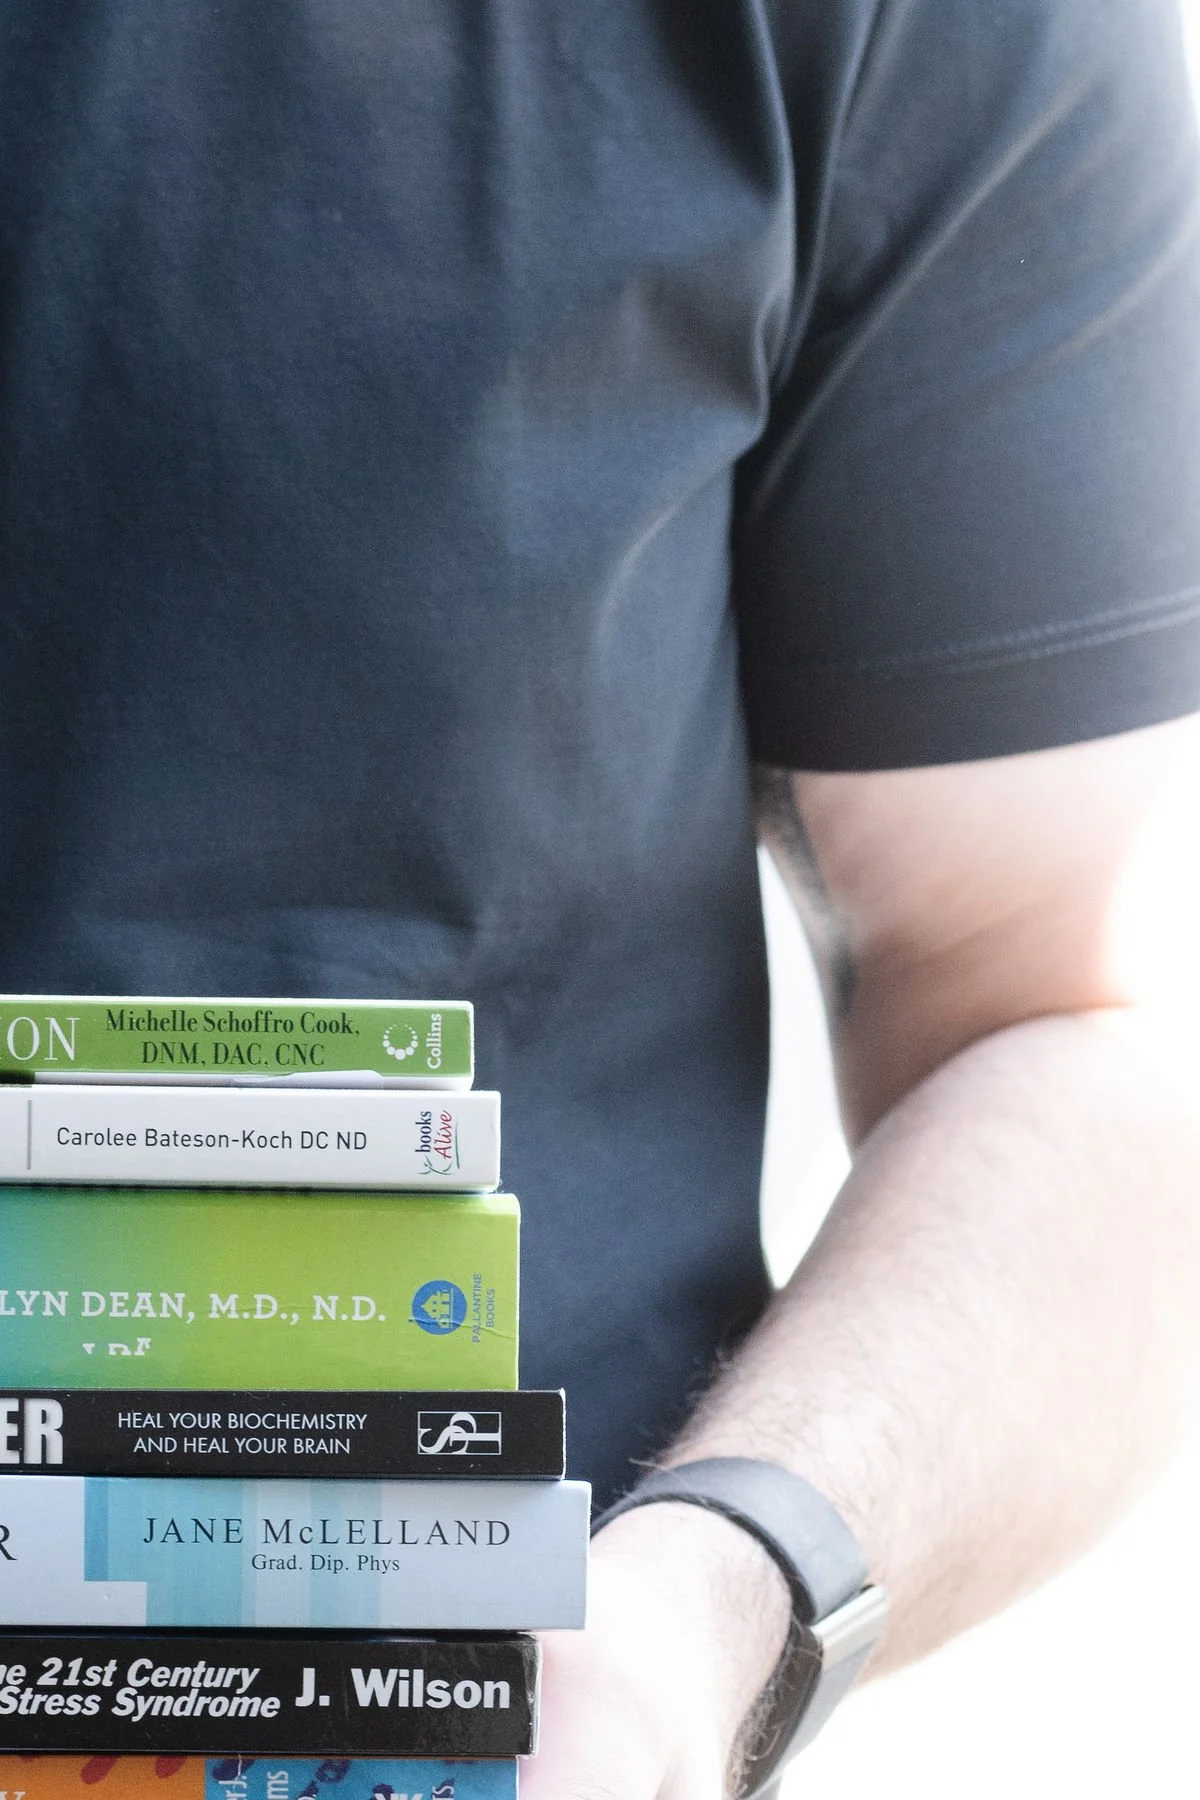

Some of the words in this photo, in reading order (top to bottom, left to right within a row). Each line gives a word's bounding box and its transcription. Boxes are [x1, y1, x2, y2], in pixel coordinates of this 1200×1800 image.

[106, 1008, 197, 1032] Michelle
[203, 1011, 294, 1034] Schoffro
[300, 1012, 360, 1036] Cook,
[276, 1044, 325, 1067] CNC
[426, 1013, 442, 1069] Collins
[56, 1127, 137, 1148] Carolee
[144, 1128, 293, 1151] Bateson-Koch
[299, 1129, 329, 1151] DC
[336, 1129, 368, 1151] ND
[415, 1111, 431, 1152] books
[434, 1110, 452, 1159] Alive
[81, 1291, 196, 1324] DEAN,
[209, 1294, 300, 1325] M.D.,
[312, 1296, 387, 1322] N.D.
[486, 1289, 495, 1328] BOOKS
[118, 1411, 164, 1430] HEAL
[170, 1411, 223, 1431] YOUR
[229, 1411, 368, 1432] BIOCHEMISTRY
[133, 1436, 177, 1455] AND
[182, 1436, 229, 1456] HEAL
[234, 1436, 287, 1456] YOUR
[292, 1436, 351, 1456] BRAIN
[143, 1517, 244, 1546] JANE
[263, 1518, 510, 1546] McLELLAND
[252, 1554, 303, 1571] Grad.
[311, 1555, 349, 1574] Dip.
[357, 1555, 400, 1574] Phys
[36, 1658, 117, 1688] 21st
[127, 1659, 260, 1693] Century
[295, 1667, 331, 1707] J.
[351, 1668, 511, 1709] Wilson
[111, 1689, 280, 1722] Syndrome
[218, 1775, 248, 1789] J.
